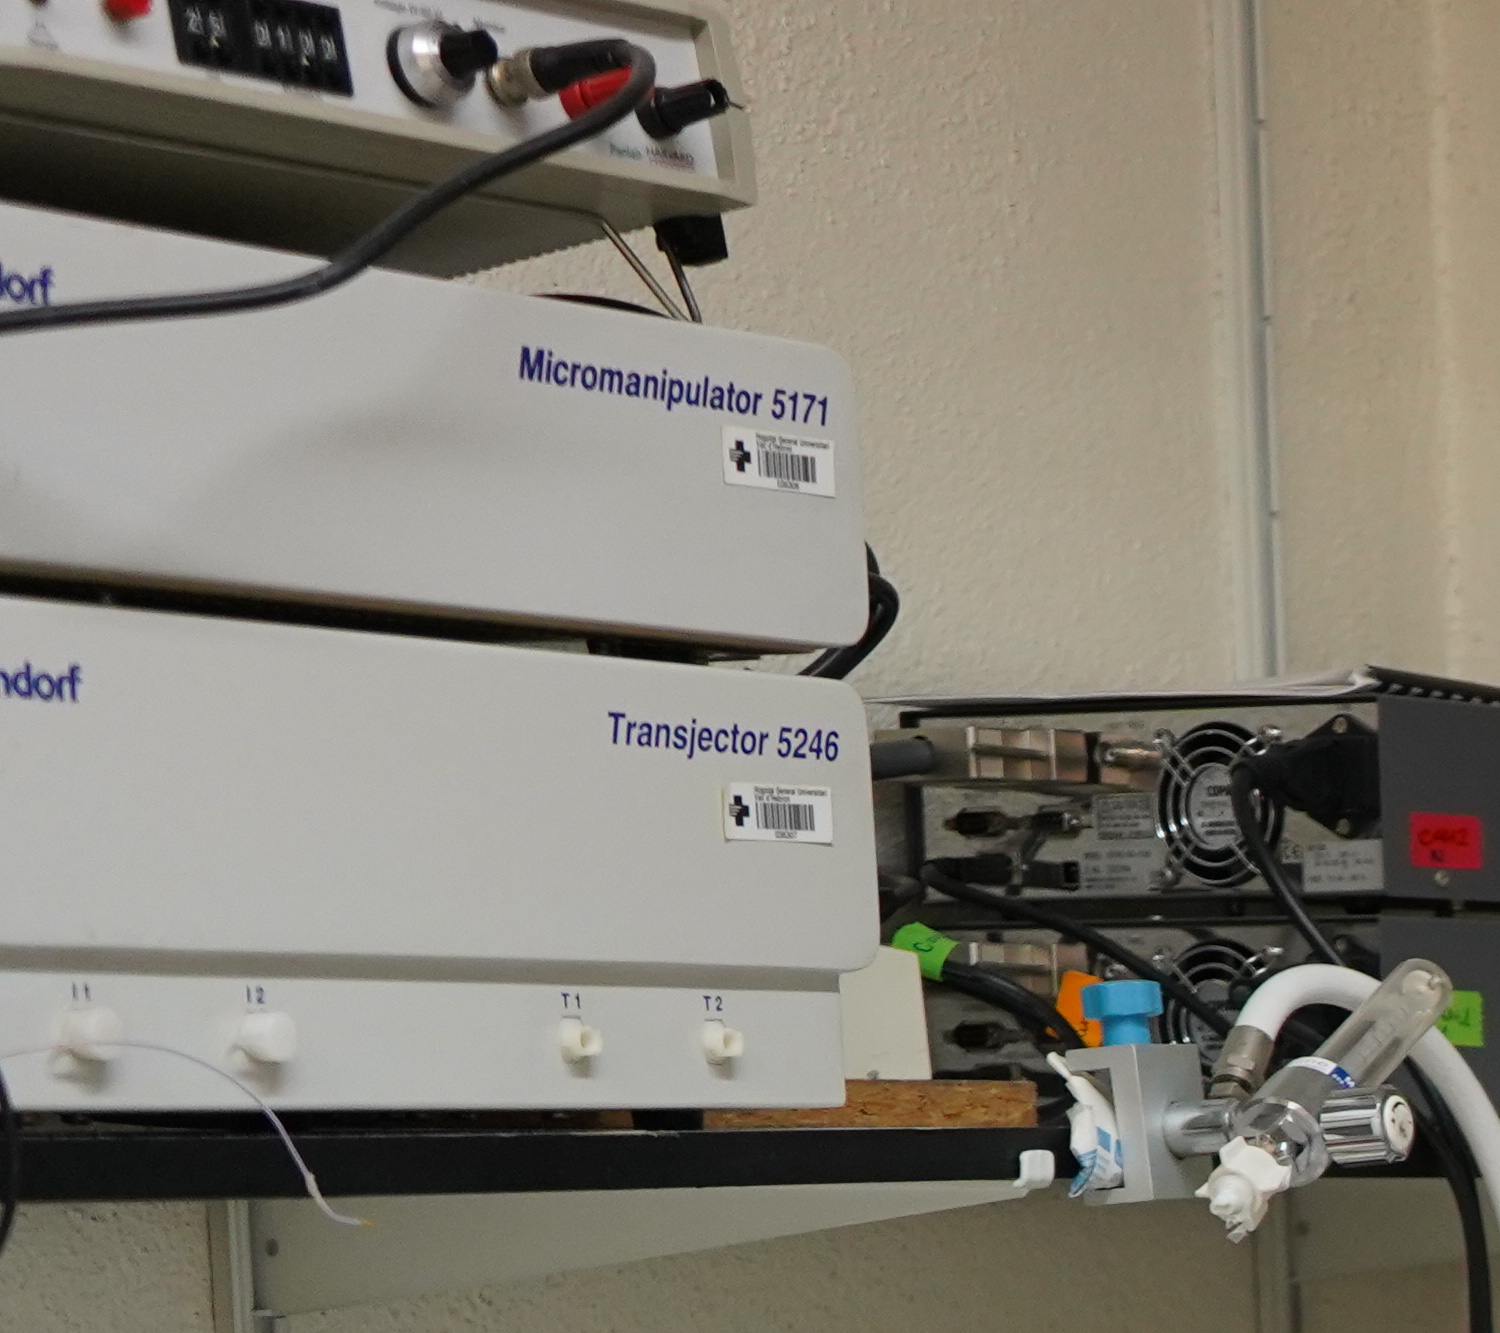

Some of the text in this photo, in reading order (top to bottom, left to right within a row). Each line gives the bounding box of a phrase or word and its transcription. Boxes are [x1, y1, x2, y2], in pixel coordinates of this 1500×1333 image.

[519, 345, 828, 427] Micromanipulator 5171
[608, 711, 840, 762] Transjector 5246
